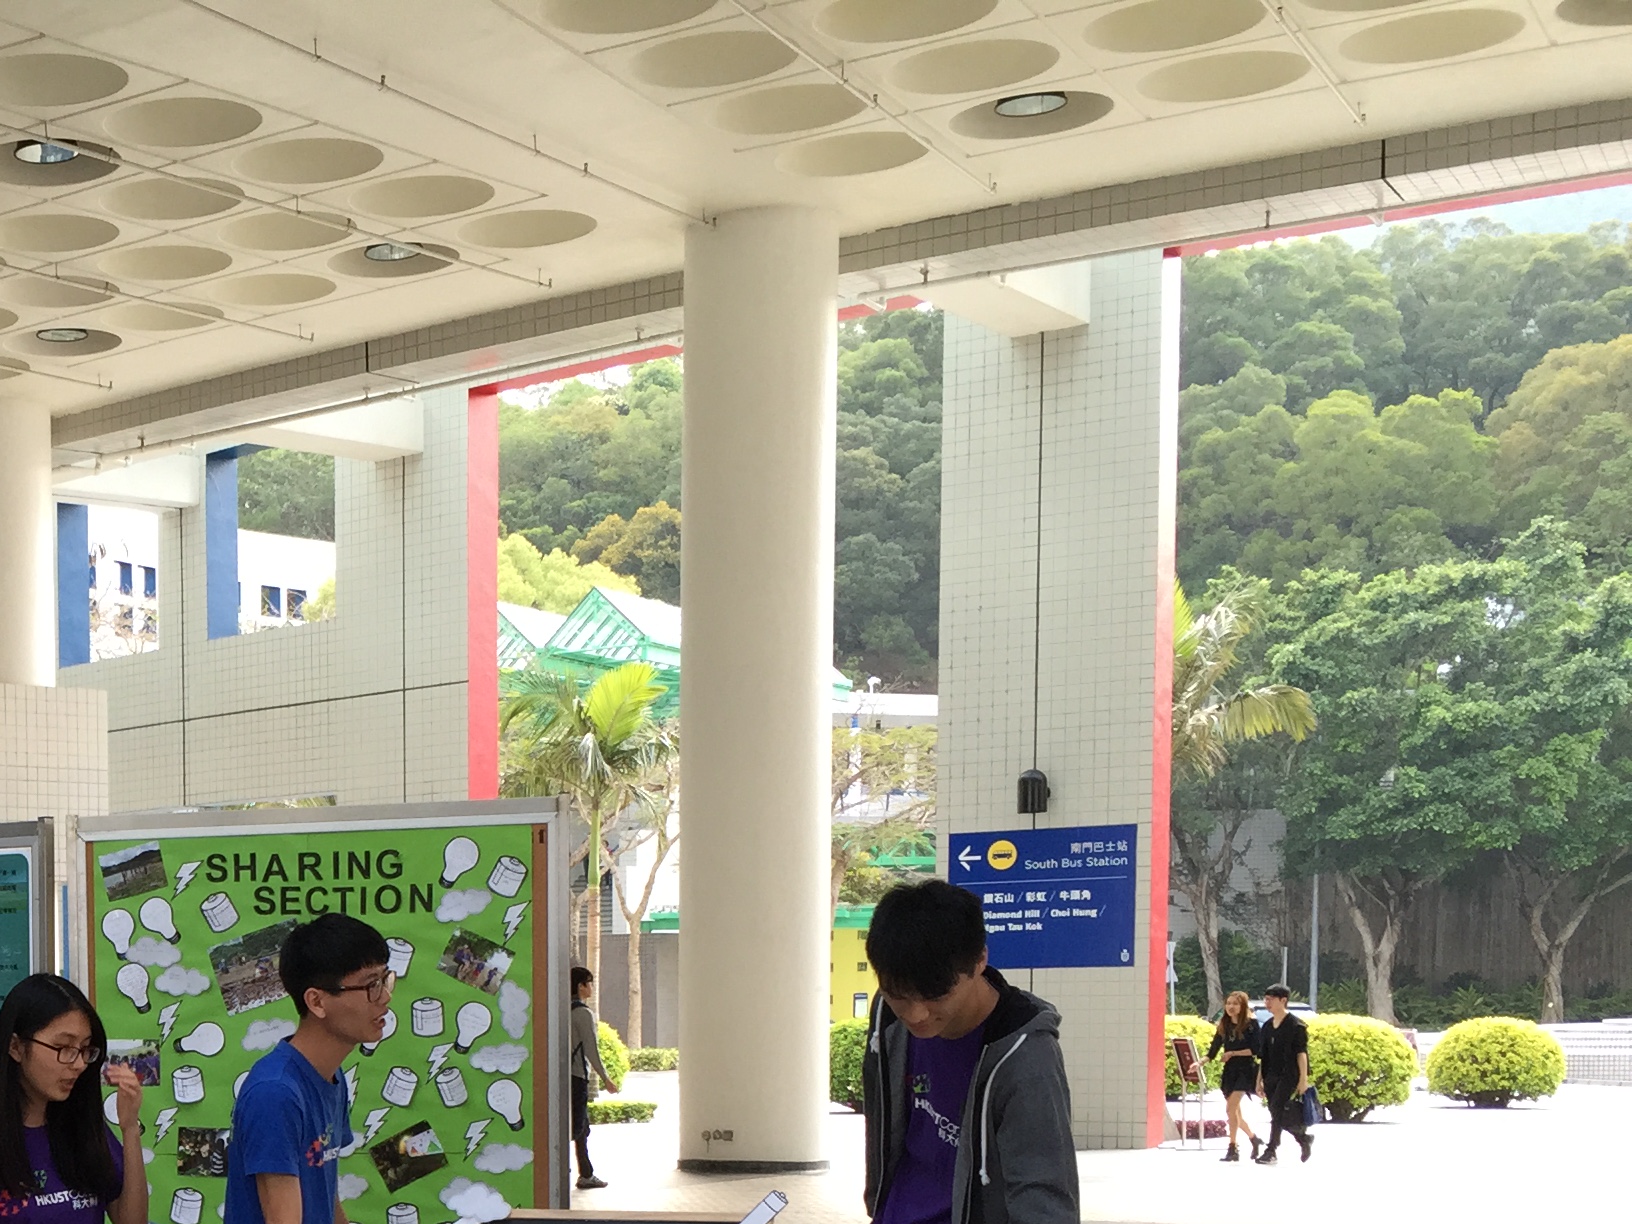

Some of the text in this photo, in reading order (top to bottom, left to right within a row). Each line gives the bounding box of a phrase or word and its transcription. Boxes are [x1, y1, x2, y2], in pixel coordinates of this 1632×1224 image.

[1071, 840, 1128, 854] 南門巴士站
[205, 849, 404, 883] SHARING
[1024, 855, 1128, 870] South Bus Station
[253, 883, 434, 916] SECTION
[983, 908, 1098, 920] Diamond Hill Choi Hung
[1007, 922, 1023, 931] Tau
[1025, 922, 1043, 931] Kok
